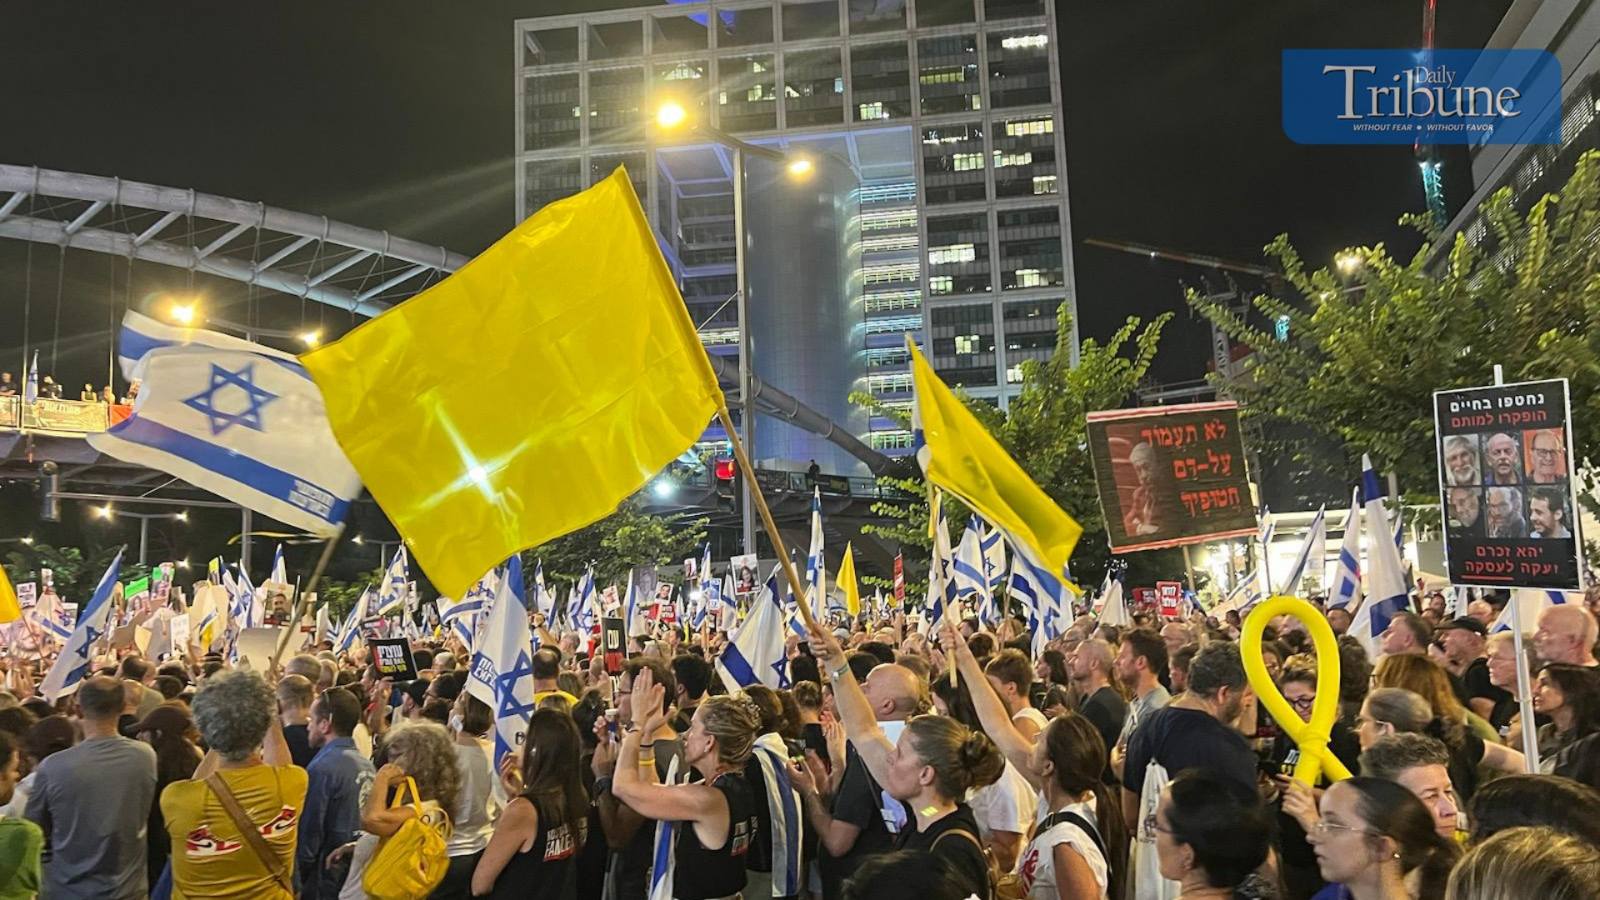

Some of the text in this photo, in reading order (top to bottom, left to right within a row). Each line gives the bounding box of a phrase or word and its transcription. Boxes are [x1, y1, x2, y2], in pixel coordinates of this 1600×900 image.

[1450, 393, 1544, 412] נחטפו בחיים
[1452, 411, 1547, 427] הופקרו למותם
[1475, 546, 1543, 557] יהא זכרם
[1464, 560, 1514, 574] לעסקה
